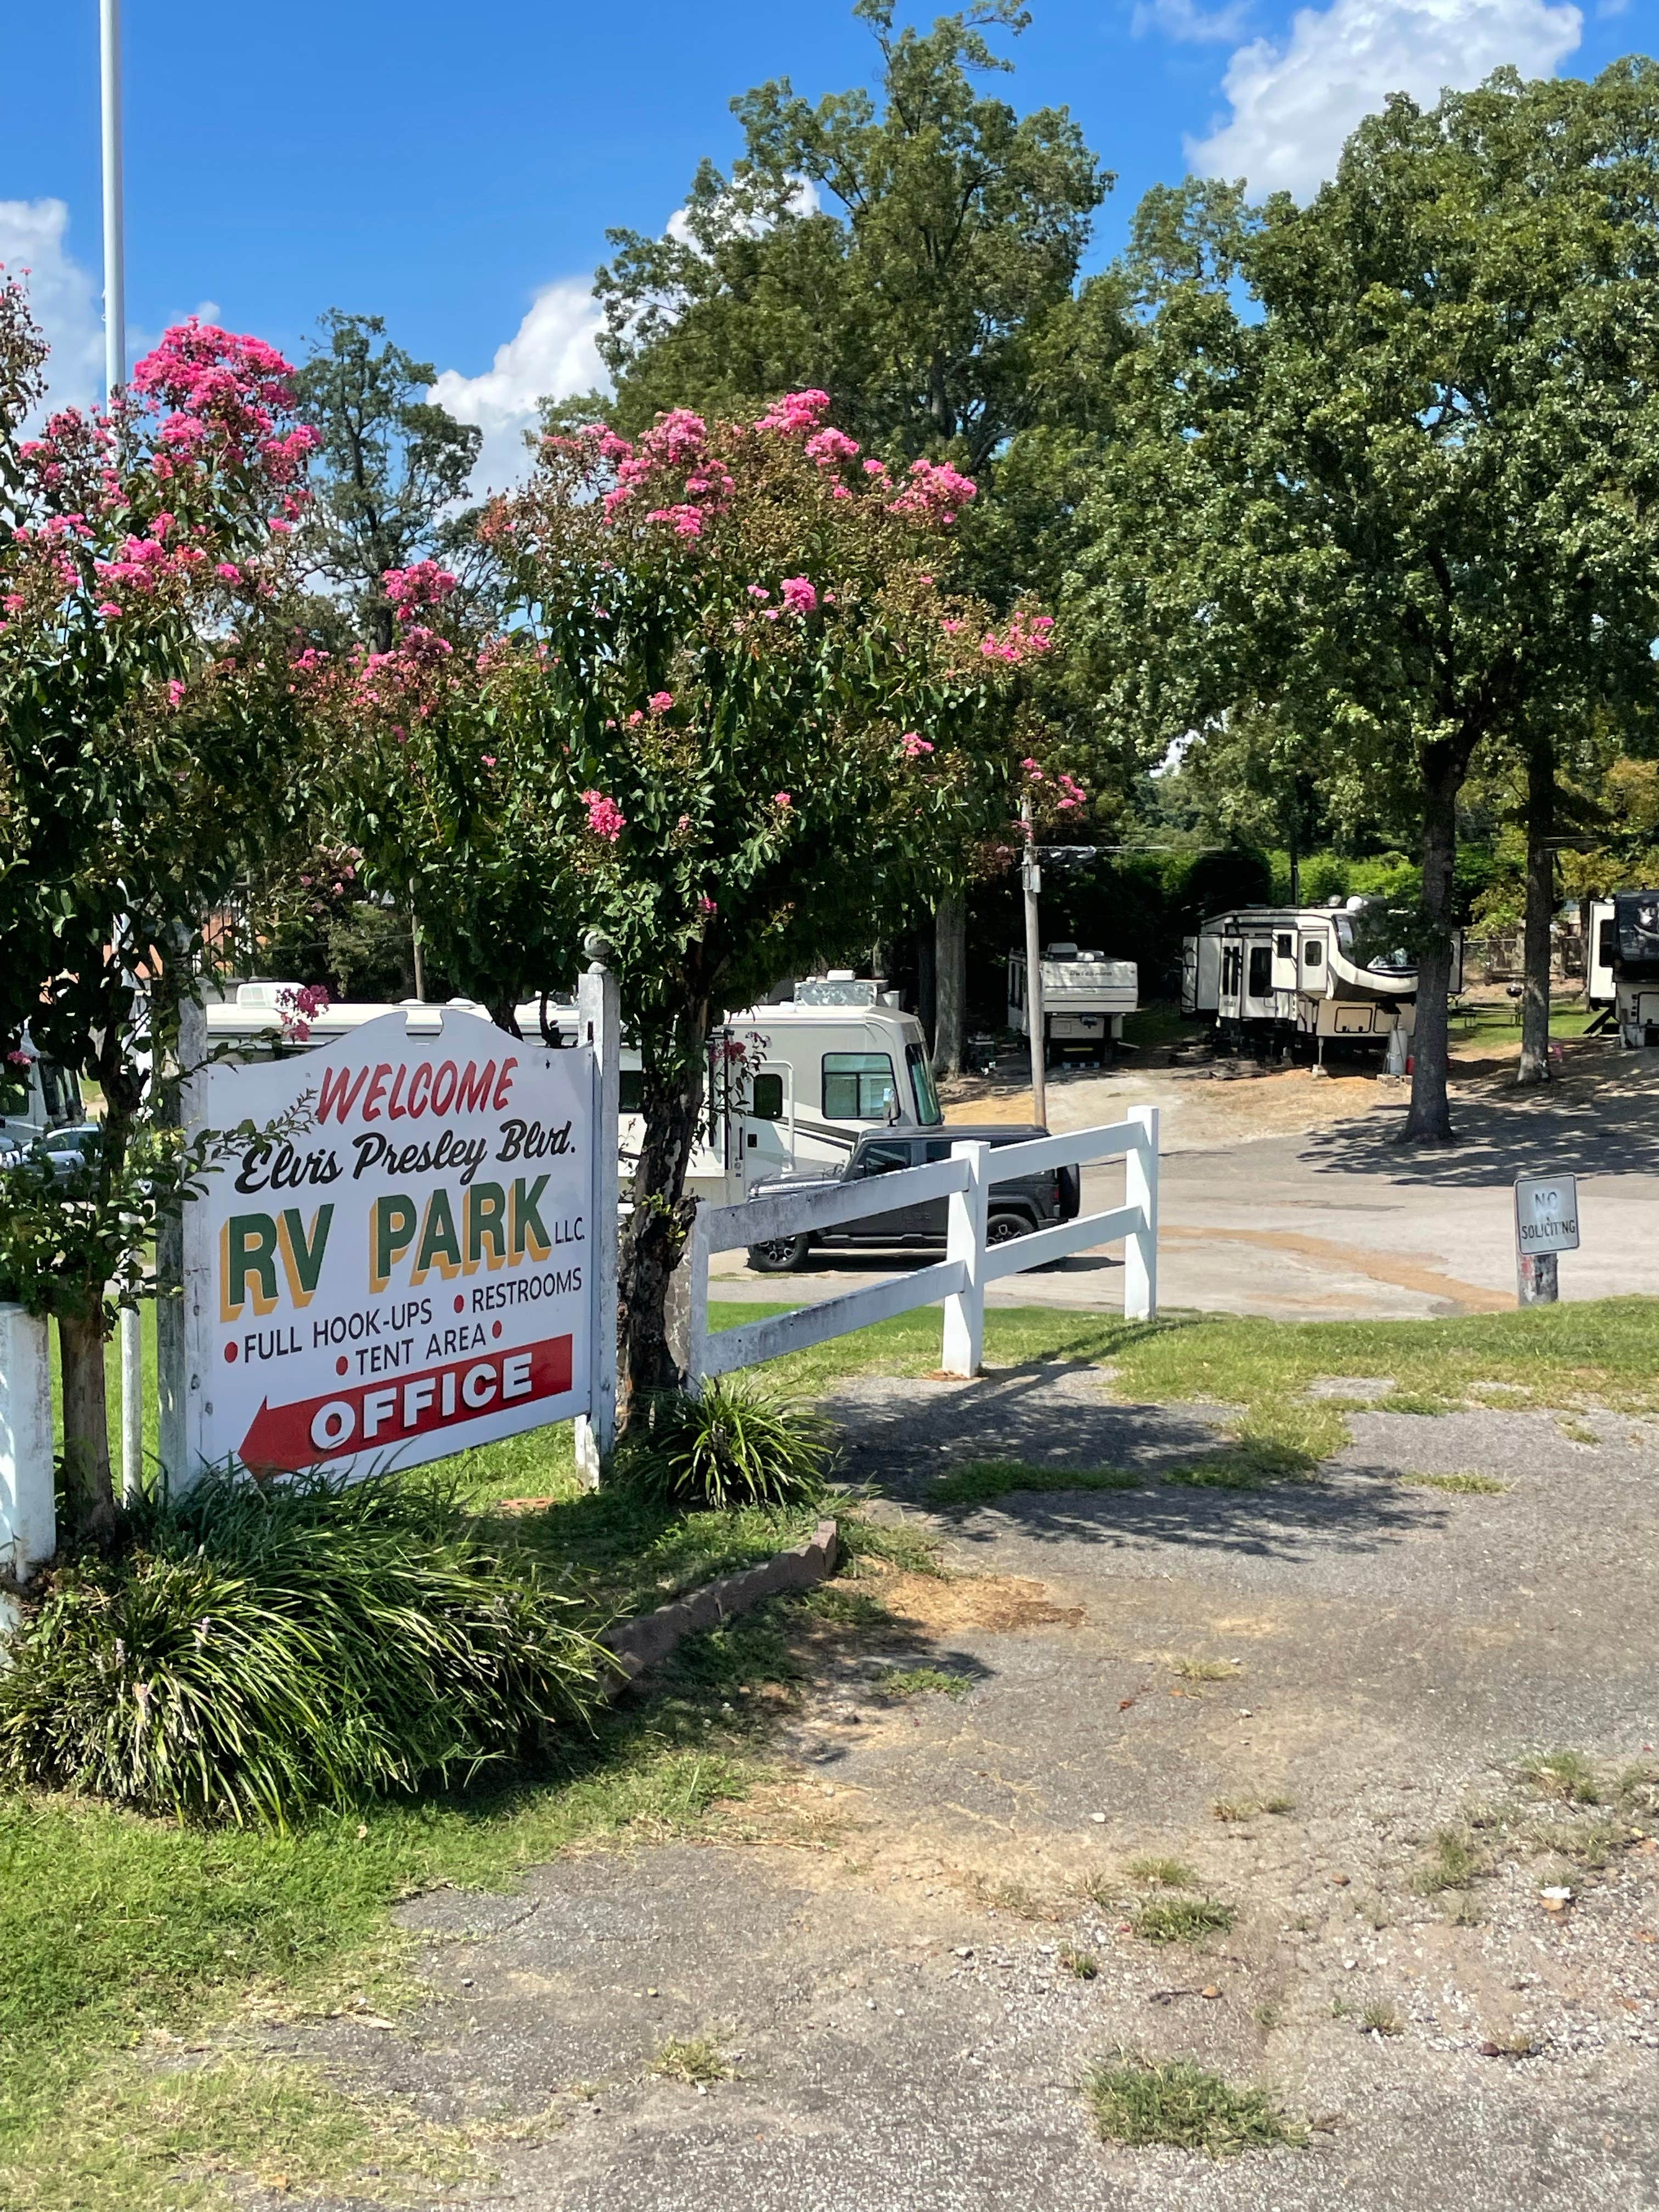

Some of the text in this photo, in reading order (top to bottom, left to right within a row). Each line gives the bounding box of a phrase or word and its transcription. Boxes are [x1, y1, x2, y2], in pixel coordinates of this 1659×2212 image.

[315, 1058, 518, 1126] WELCOME
[234, 1119, 575, 1194] Elvis Presley Blvd.
[1534, 1191, 1558, 1210] NO
[220, 1173, 585, 1323] RV PARK LLC
[244, 1267, 582, 1363] FULL HOOK-UPS RESTROOMS
[355, 1322, 487, 1376] TENT AREA
[311, 1352, 532, 1450] OFFICE
